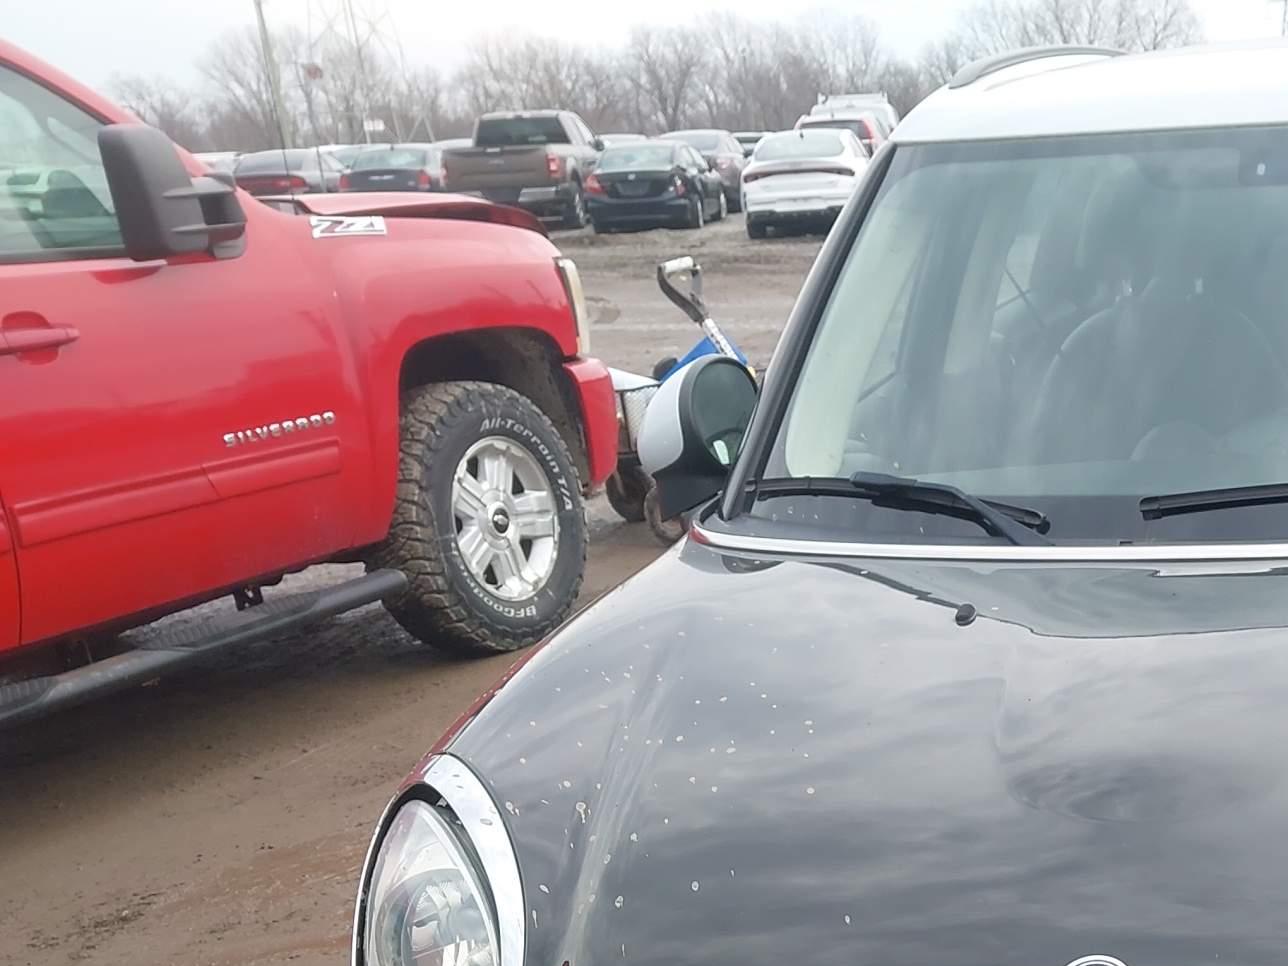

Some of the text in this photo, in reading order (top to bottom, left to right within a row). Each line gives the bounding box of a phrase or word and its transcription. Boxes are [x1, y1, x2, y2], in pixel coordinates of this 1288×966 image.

[223, 411, 335, 448] SILVERADO
[479, 418, 574, 511] All-Terrain T/A
[456, 558, 538, 619] BFGoodr
